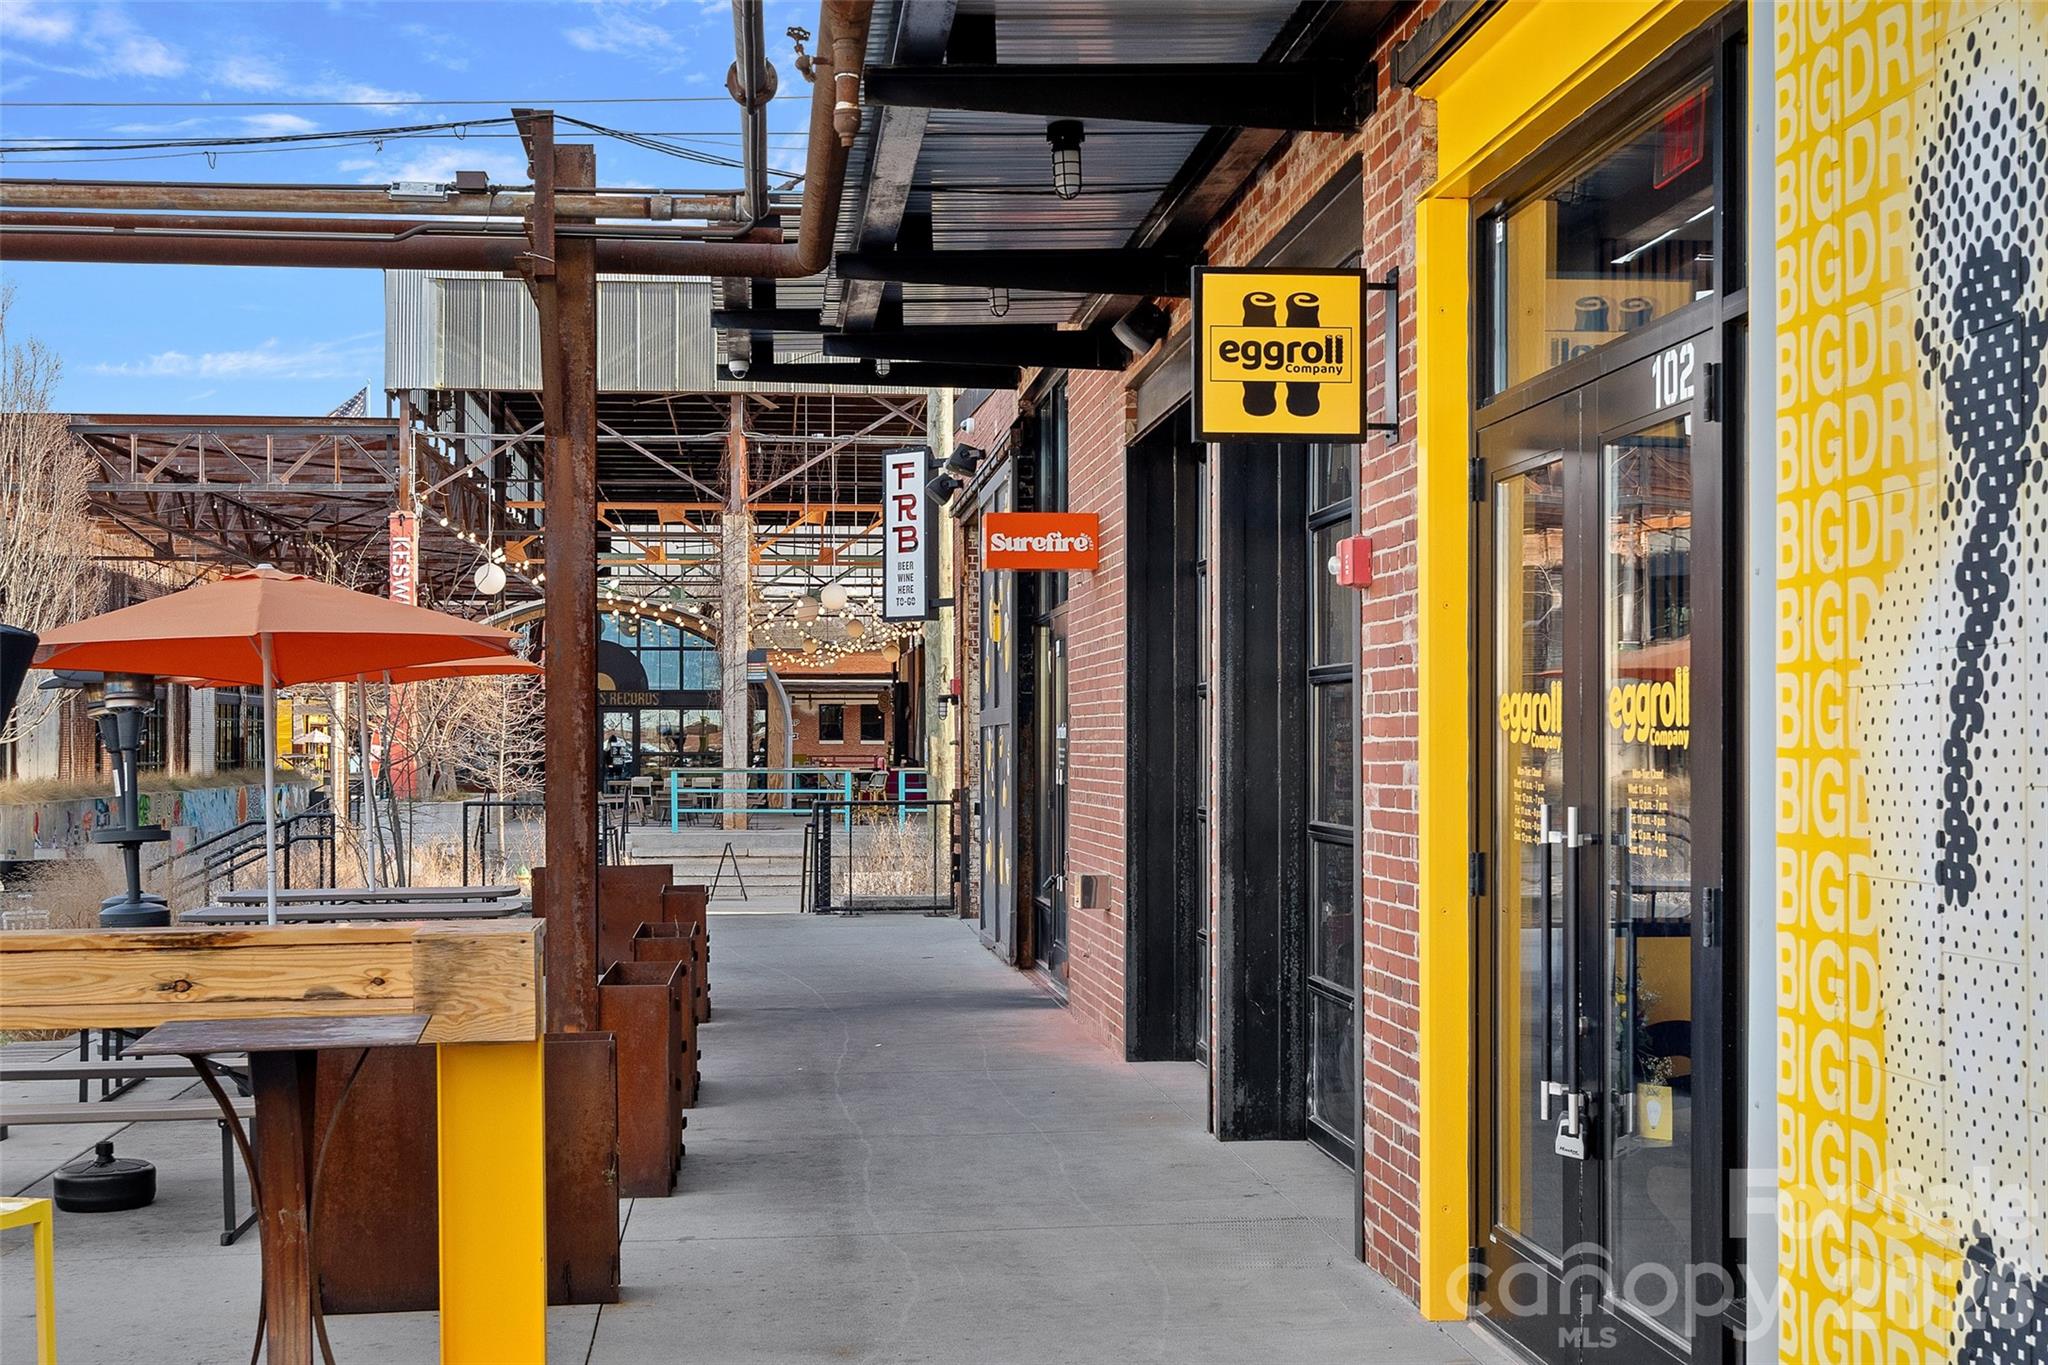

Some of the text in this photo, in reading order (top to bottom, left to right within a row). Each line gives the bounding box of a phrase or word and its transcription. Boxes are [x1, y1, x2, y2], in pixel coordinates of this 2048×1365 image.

[1219, 335, 1343, 370] eggroll
[1285, 364, 1343, 375] Company
[1652, 342, 1695, 409] 102
[892, 462, 919, 553] FRB
[990, 530, 1090, 552] Surefire
[392, 537, 411, 604] KESW
[897, 561, 914, 571] BEER
[897, 573, 914, 582] WINE
[897, 585, 914, 594] HERE
[896, 597, 916, 606] TO-GO
[610, 691, 660, 705] RECORDS
[1608, 666, 1690, 743] eggroll
[1500, 680, 1563, 744] eggroll
[1531, 733, 1562, 752] Company
[1650, 729, 1690, 750] Company
[1776, 931, 1881, 1030] BIGD
[1776, 1017, 1882, 1122] BIGD
